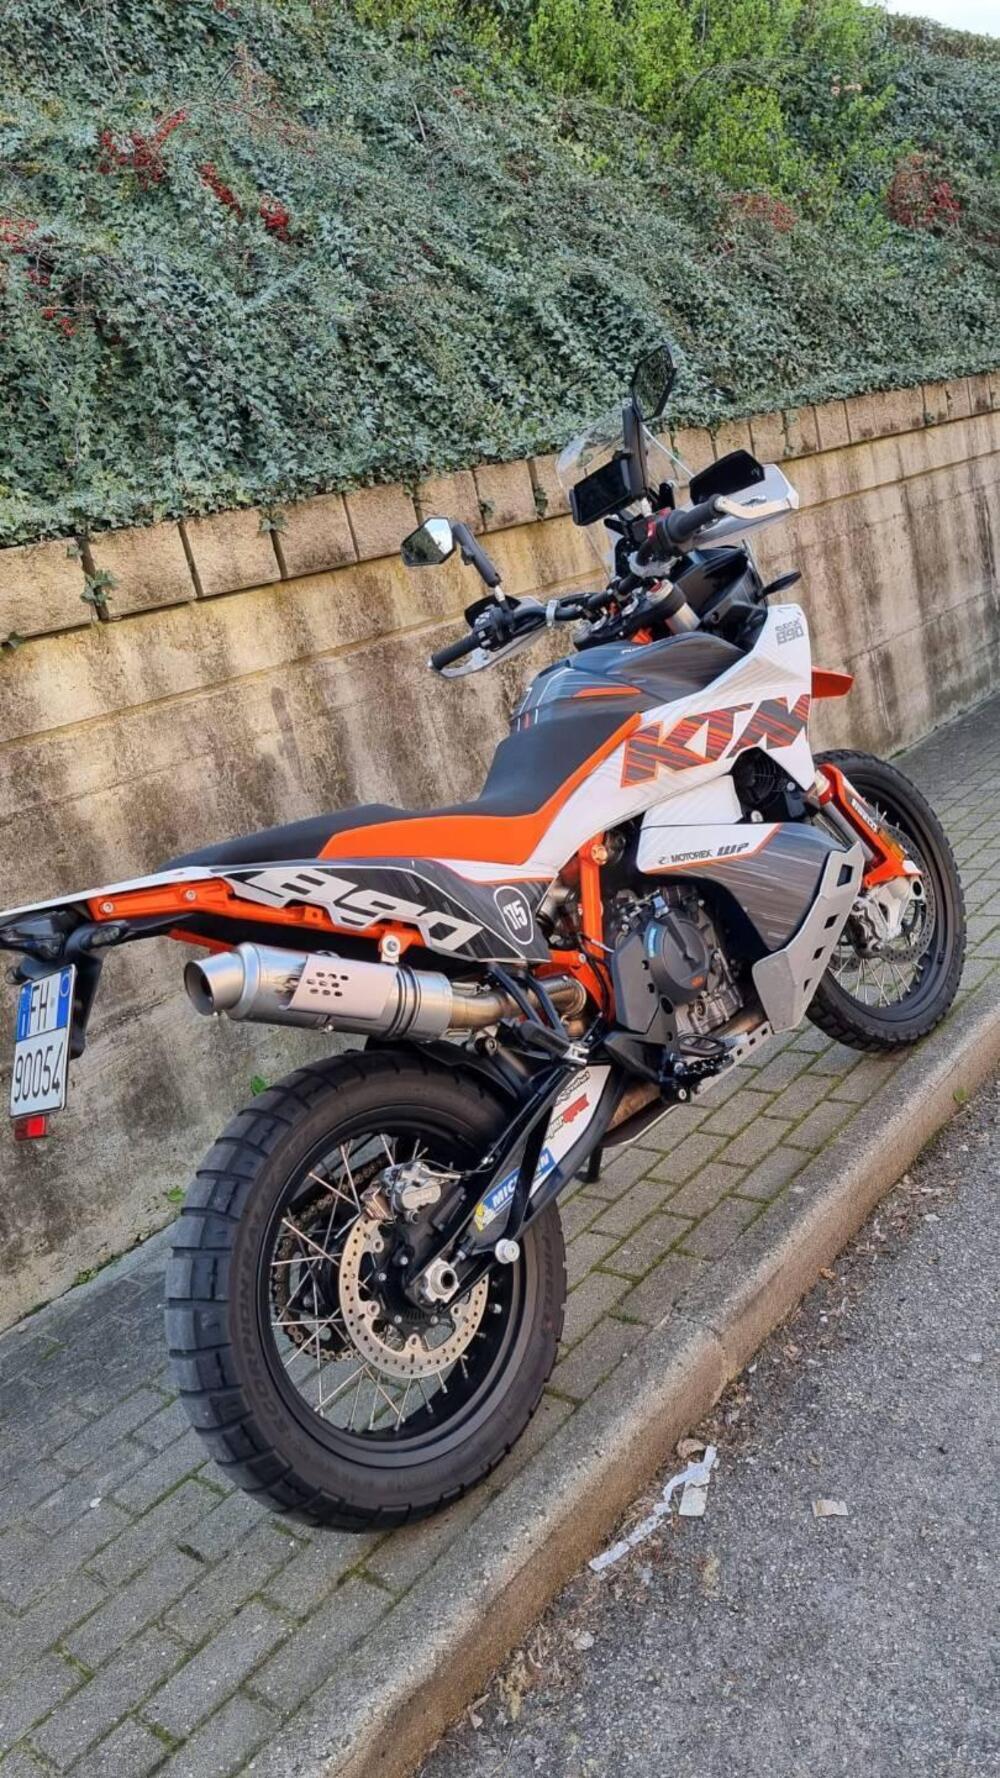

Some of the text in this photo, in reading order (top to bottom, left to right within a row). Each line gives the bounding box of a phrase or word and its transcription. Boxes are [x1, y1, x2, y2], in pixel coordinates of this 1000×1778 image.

[620, 694, 811, 789] KTM
[671, 849, 713, 862] MOTOREX
[717, 842, 749, 856] WP
[31, 981, 50, 1031] FH
[14, 1041, 63, 1103] 90054
[492, 1153, 550, 1208] MICIN
